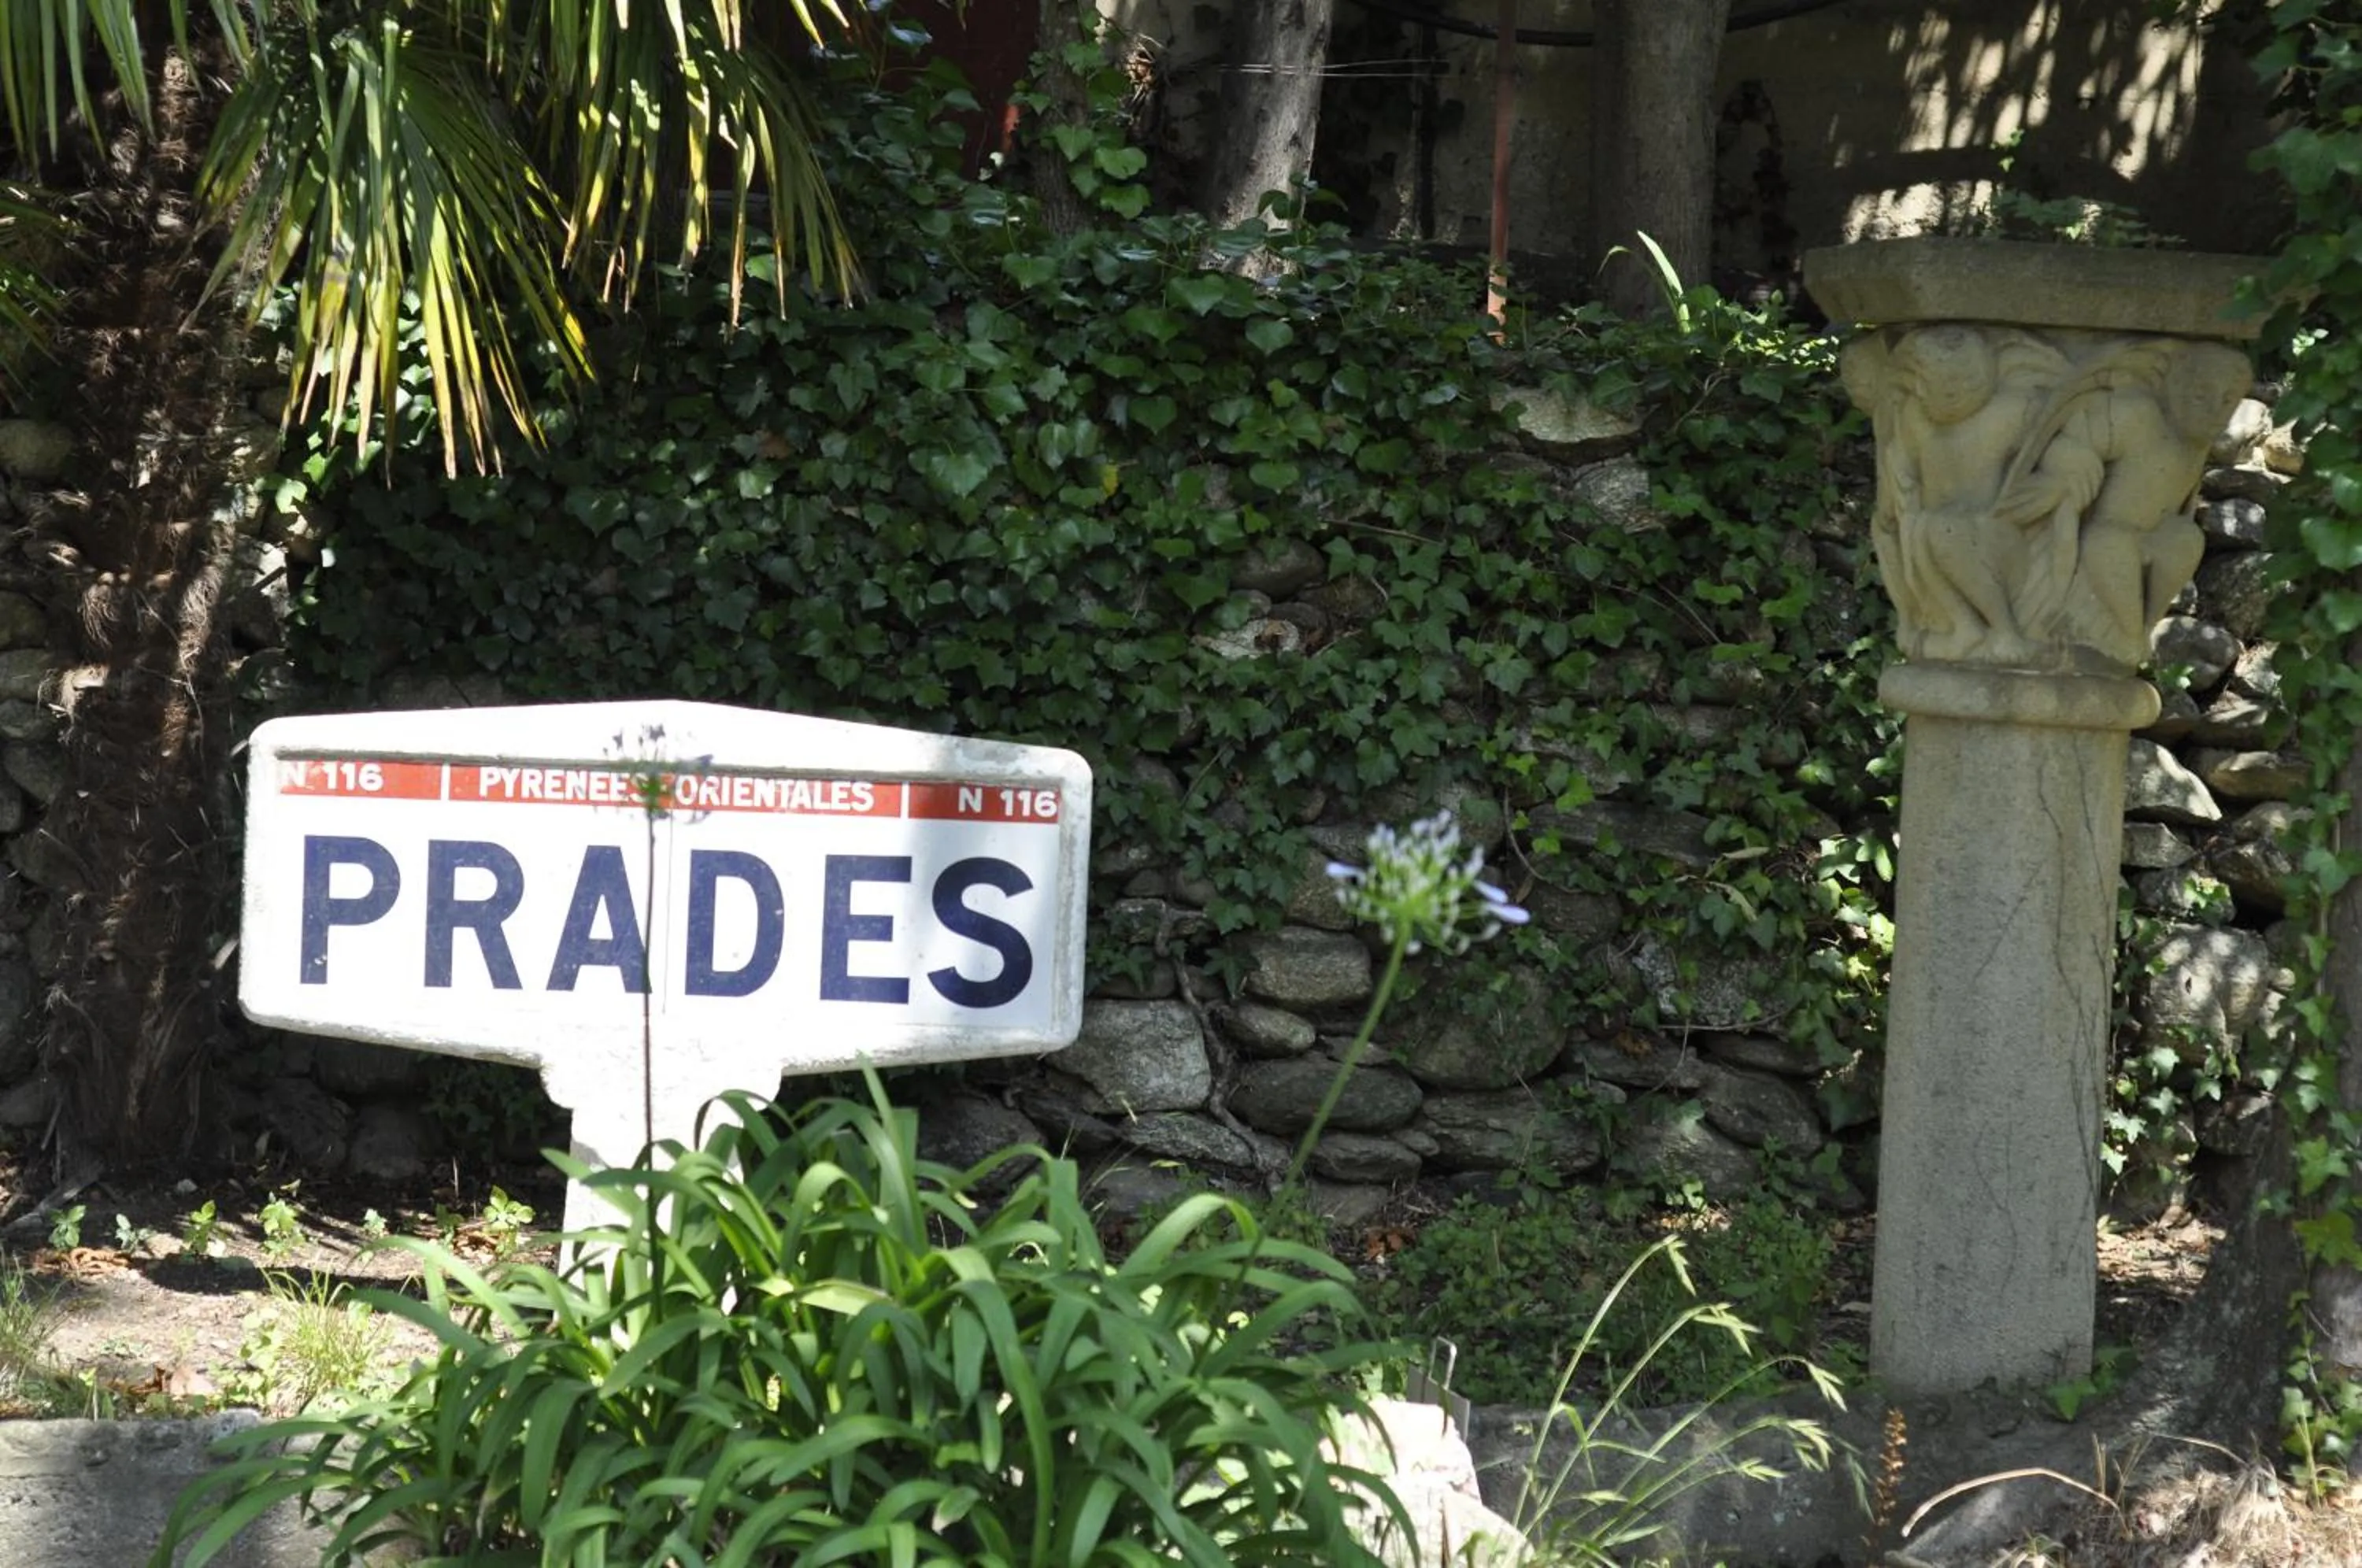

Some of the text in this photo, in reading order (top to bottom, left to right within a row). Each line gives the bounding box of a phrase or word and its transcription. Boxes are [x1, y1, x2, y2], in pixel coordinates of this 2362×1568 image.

[320, 760, 384, 791] 116
[675, 774, 874, 812] ORIENTALES
[957, 787, 1058, 817] N 116
[299, 834, 1035, 1008] PRADES
